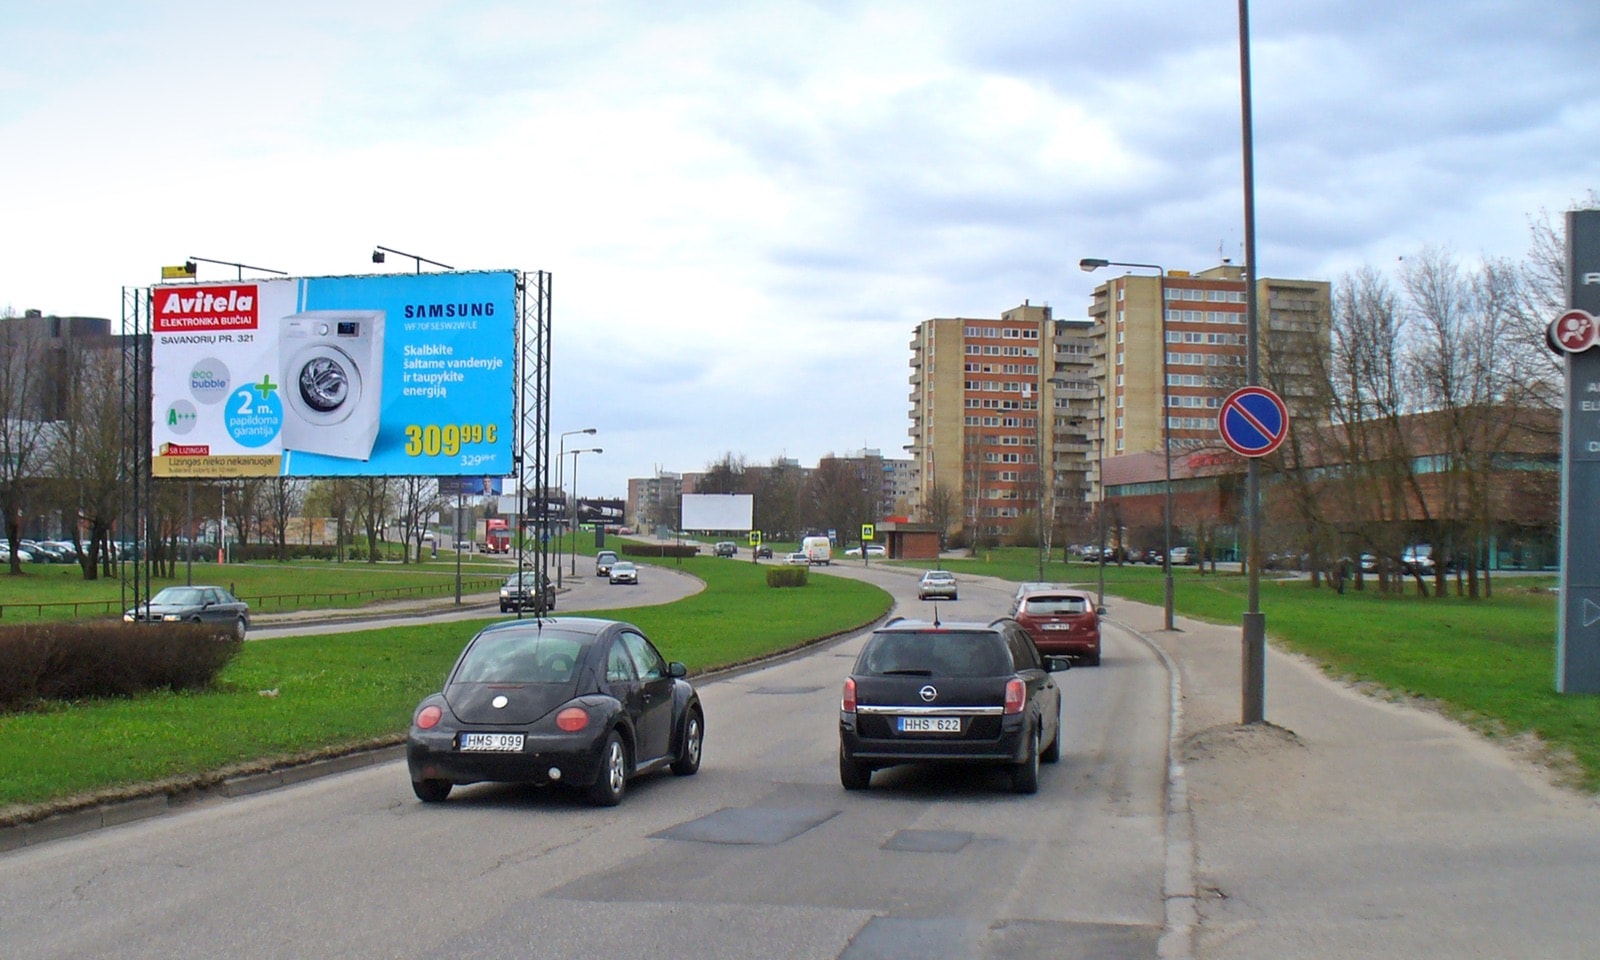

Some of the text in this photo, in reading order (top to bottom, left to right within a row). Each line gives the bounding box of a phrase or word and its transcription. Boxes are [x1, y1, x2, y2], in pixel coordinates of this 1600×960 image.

[162, 290, 253, 314] Avitela
[404, 302, 495, 319] SAMSUNG
[160, 318, 219, 327] ELEKTRONIKA
[218, 335, 235, 343] PR.
[237, 334, 254, 342] 321
[403, 344, 453, 356] Skalbkite
[403, 356, 503, 370] šaltame vandenyje
[192, 379, 226, 388] bubble
[403, 371, 464, 385] ir taupykite
[403, 386, 447, 398] energiją
[237, 390, 273, 415] 2 m.
[230, 415, 278, 427] papildoma
[233, 427, 274, 437] garantija
[904, 719, 959, 730] HHS 622
[468, 735, 522, 747] HMS 099
